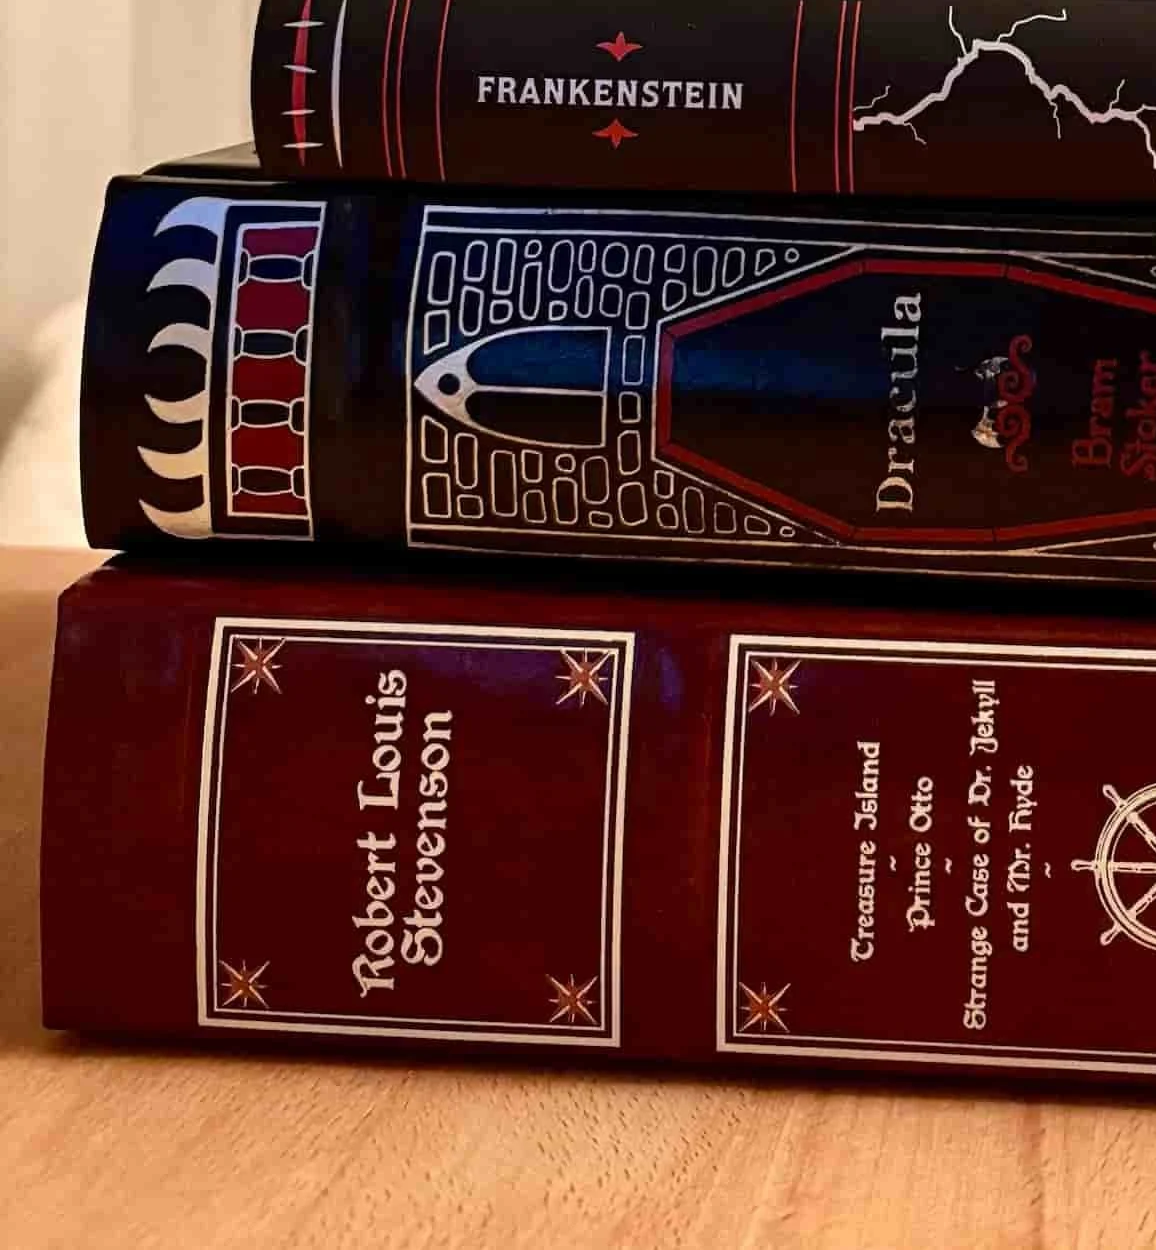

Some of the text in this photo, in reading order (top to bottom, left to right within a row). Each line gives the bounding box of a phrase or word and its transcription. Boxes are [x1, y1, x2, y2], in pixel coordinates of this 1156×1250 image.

[477, 76, 743, 110] FRANKENSTEIN
[876, 293, 922, 512] Dracula
[1072, 358, 1118, 467] Bram
[352, 669, 408, 998] Robert Louis
[401, 710, 453, 967] Stevenson
[850, 741, 880, 962] Treasure Island
[906, 776, 935, 932] Prince Otto
[963, 679, 1000, 1030] Strange Case of Dr. Jekyll
[1006, 764, 1038, 952] and Mr. Hyde
